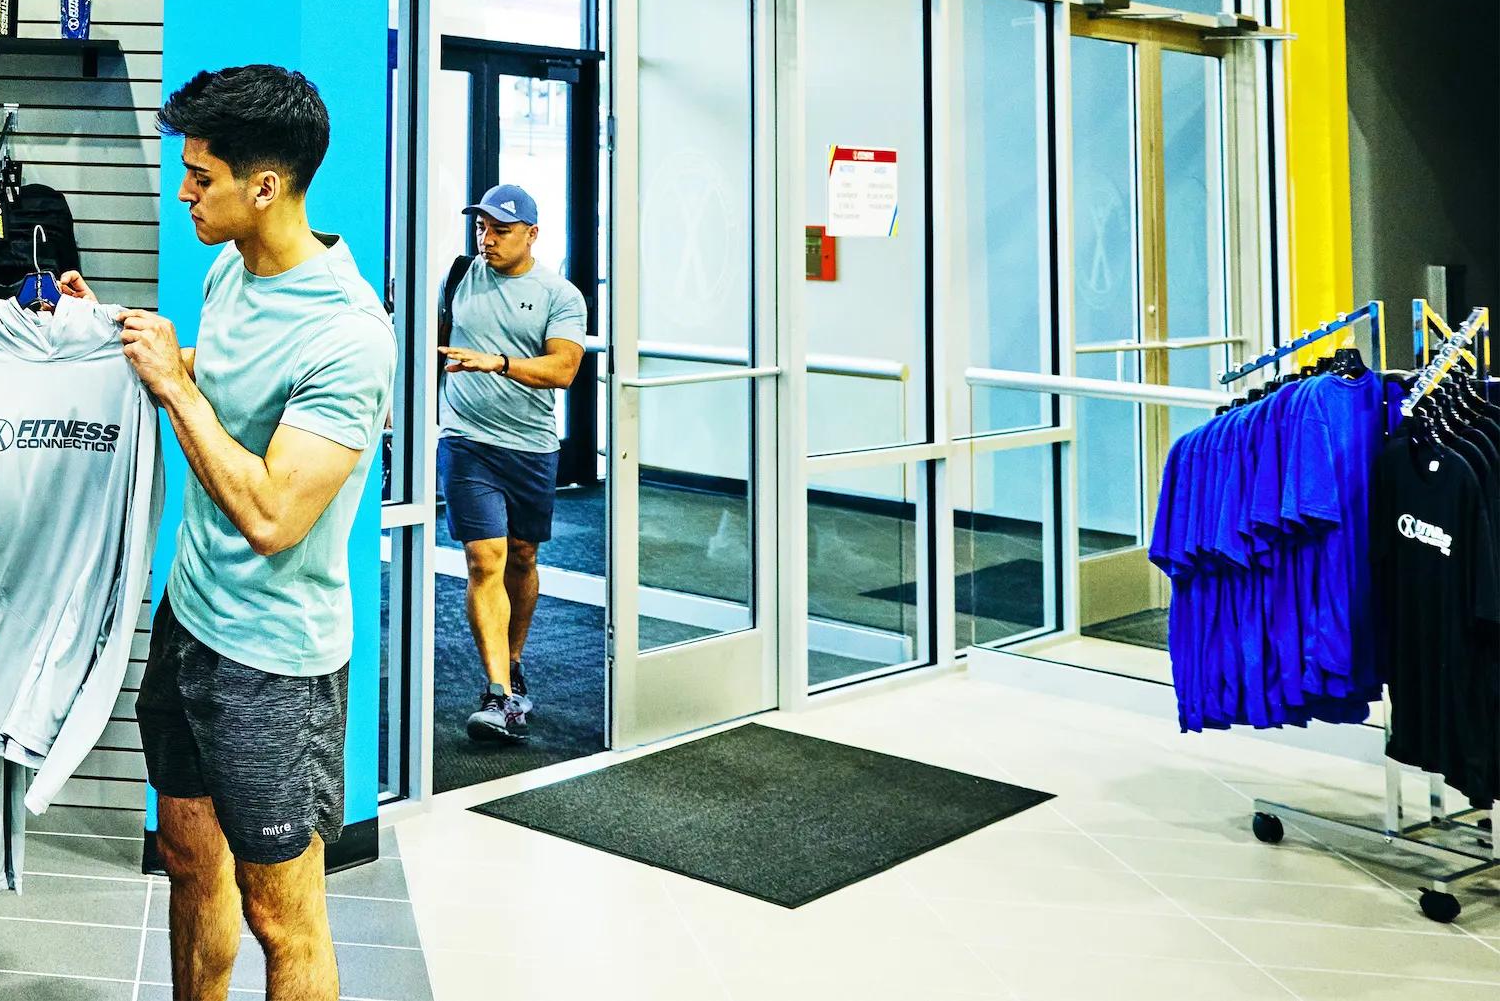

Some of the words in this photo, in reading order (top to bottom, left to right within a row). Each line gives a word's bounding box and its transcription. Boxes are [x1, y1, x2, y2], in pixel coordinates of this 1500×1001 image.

[17, 419, 121, 442] FITNESS
[16, 438, 116, 453] CONNECTION
[263, 823, 292, 836] mitre
